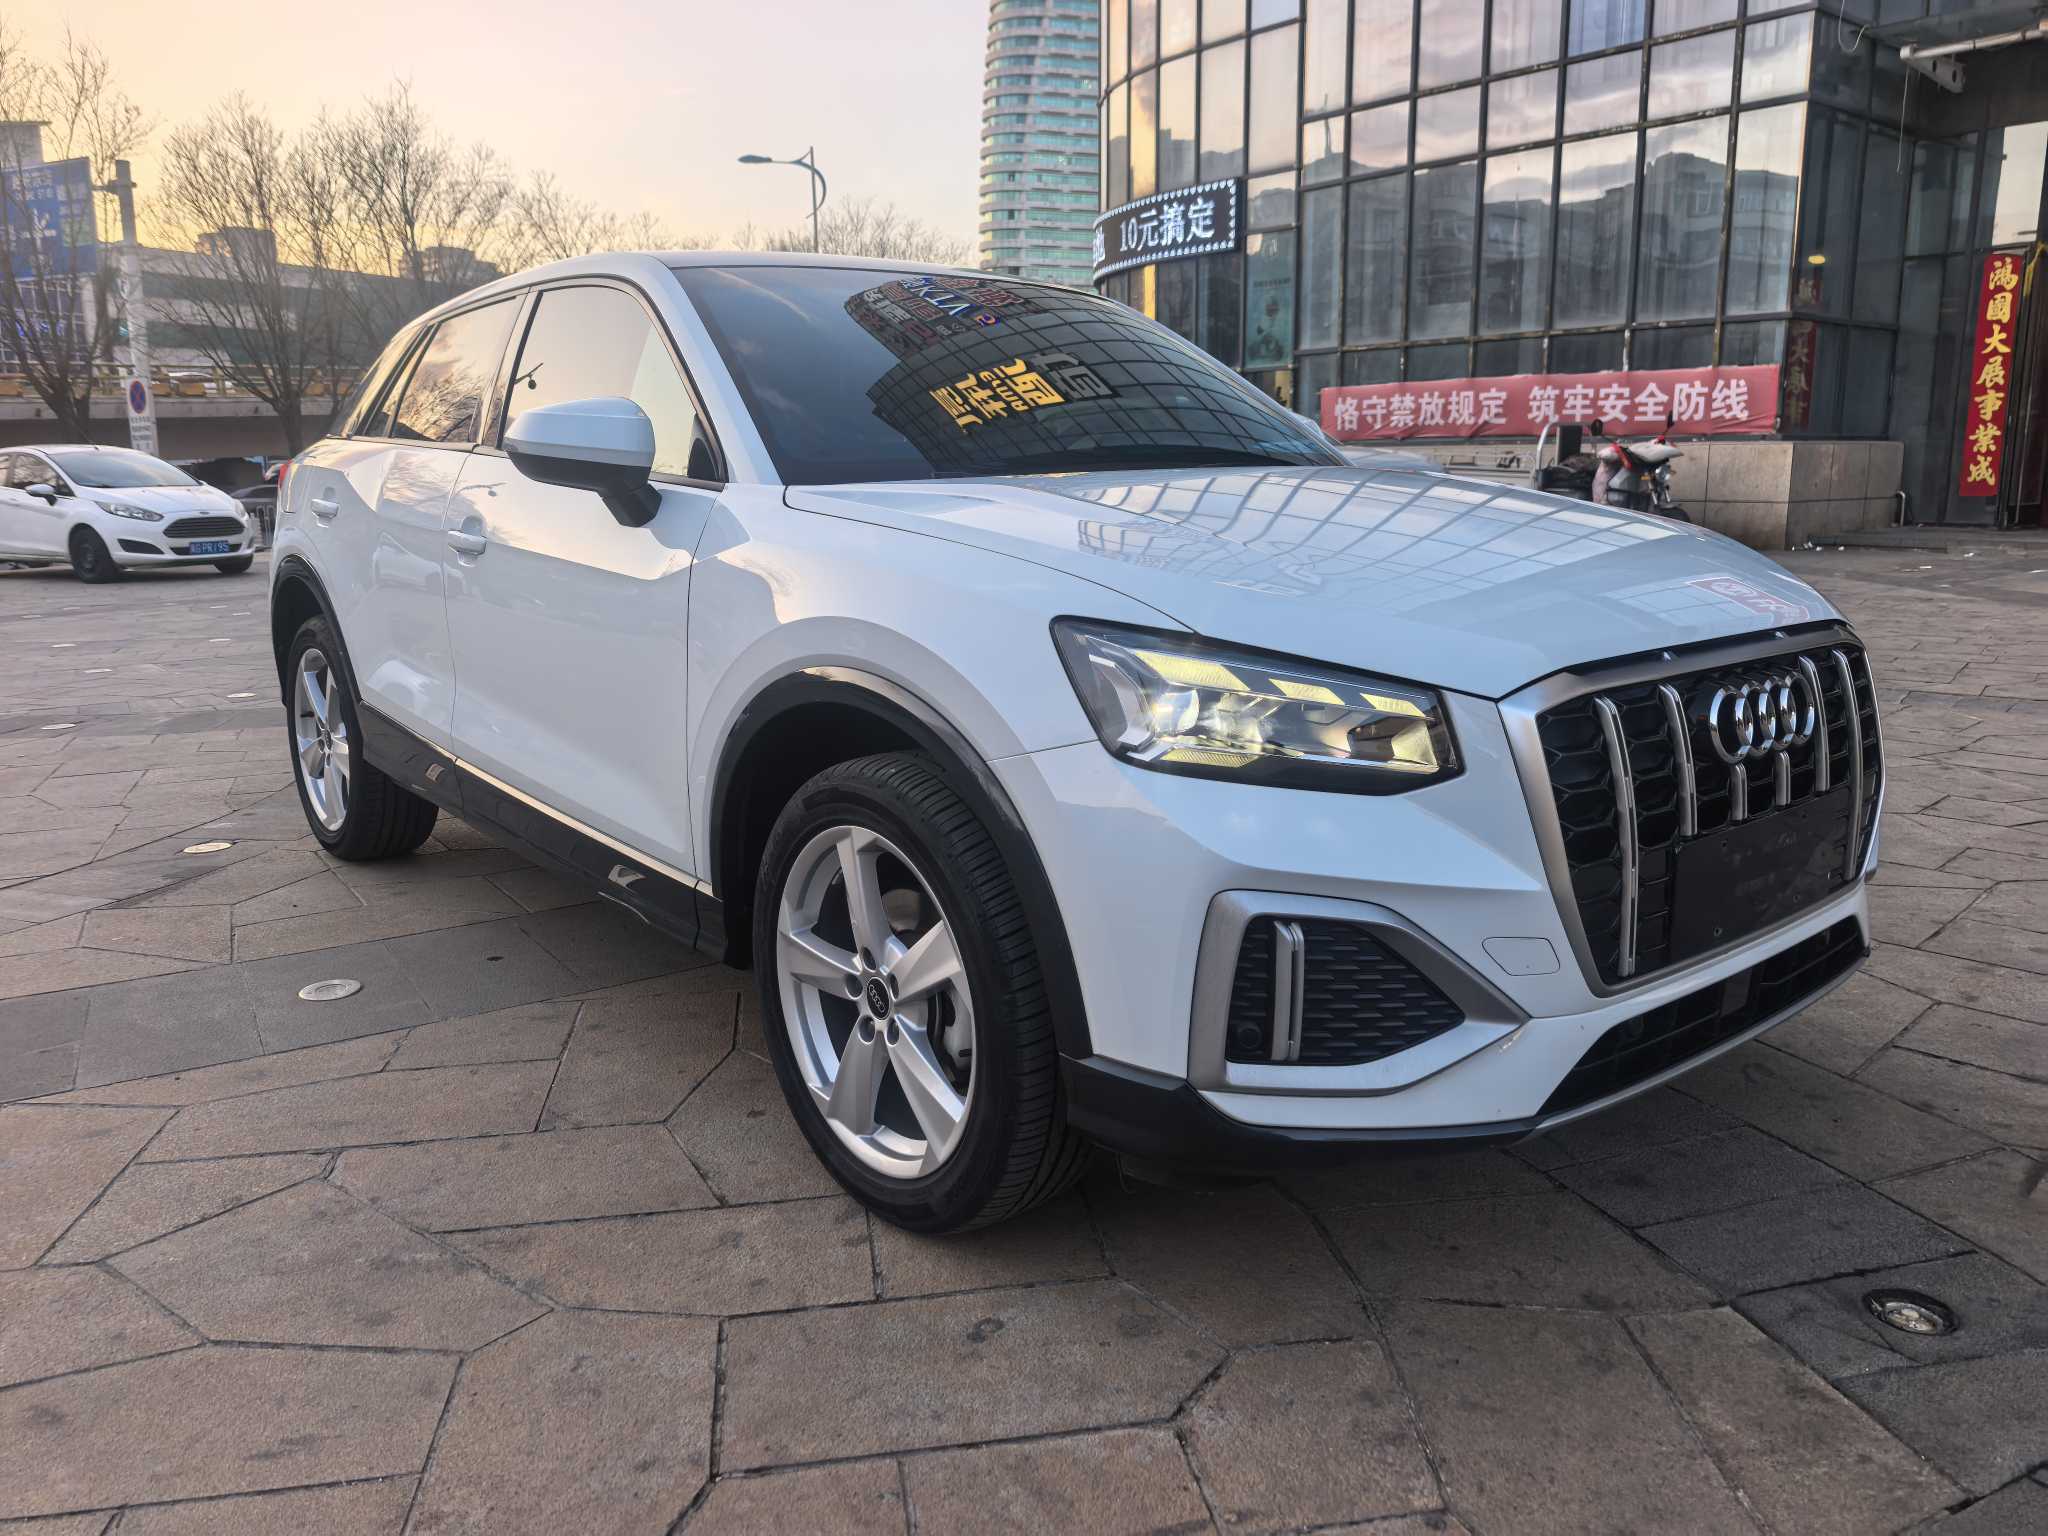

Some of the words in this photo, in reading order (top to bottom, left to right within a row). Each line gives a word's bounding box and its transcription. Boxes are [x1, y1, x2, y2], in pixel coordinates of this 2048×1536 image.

[1119, 195, 1216, 252] 10元搞定
[1334, 387, 1507, 431] 恪守禁放规定
[1528, 378, 1750, 424] 筑牢安全防线
